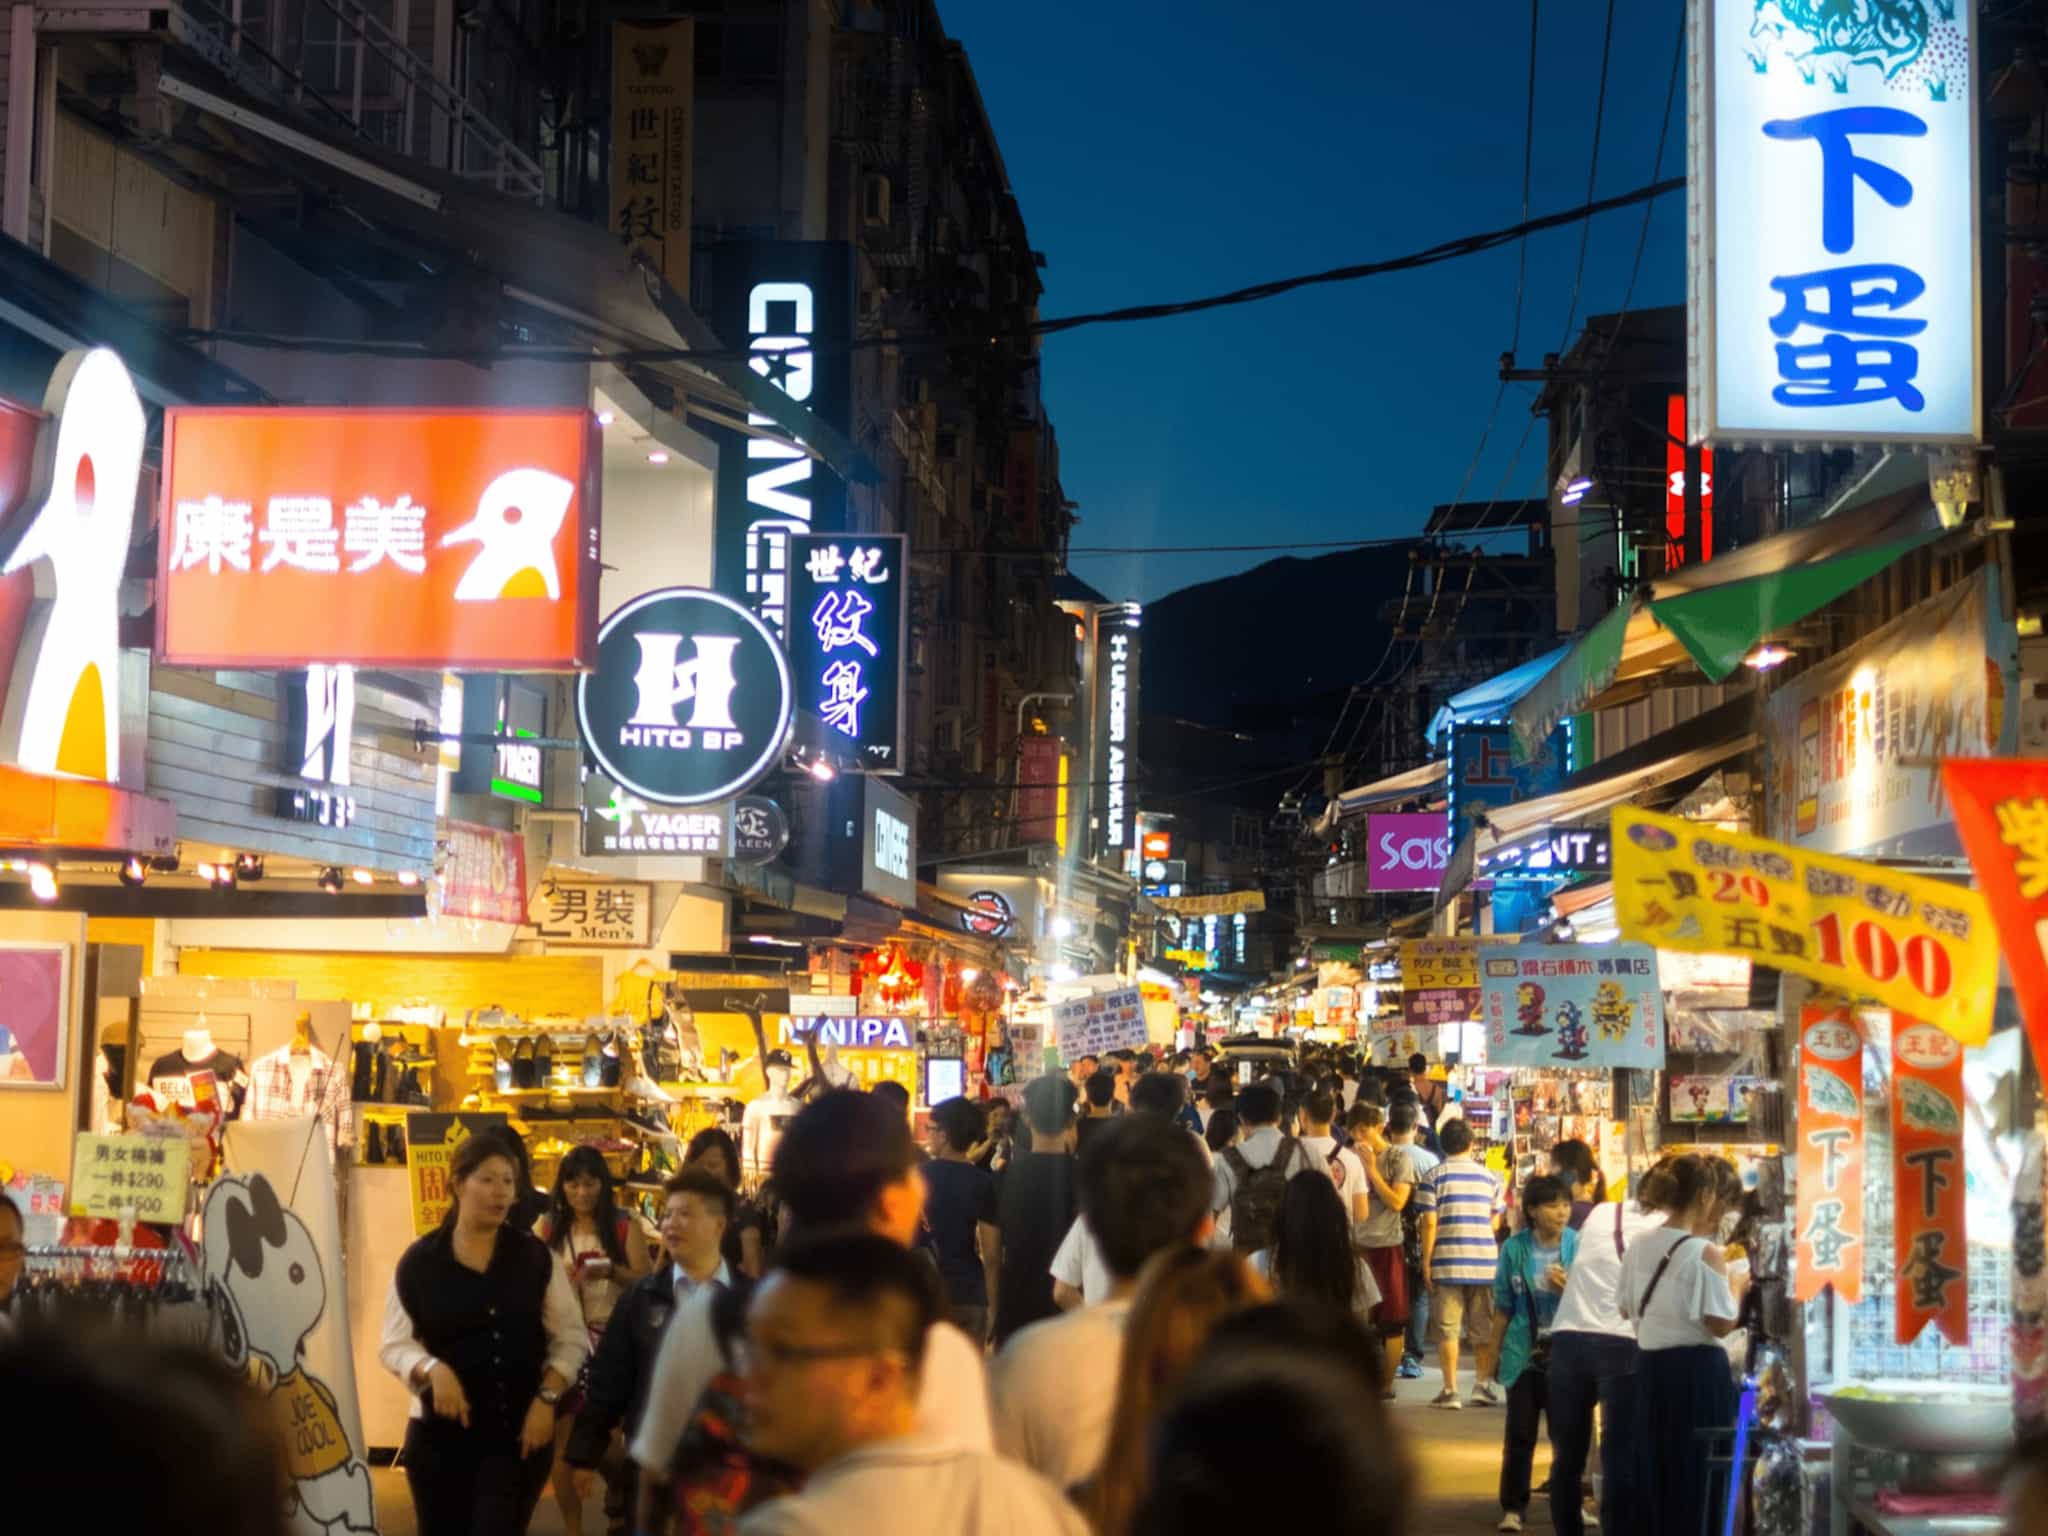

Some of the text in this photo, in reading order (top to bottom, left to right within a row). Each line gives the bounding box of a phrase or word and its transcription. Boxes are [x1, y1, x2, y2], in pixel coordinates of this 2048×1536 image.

[1762, 106, 1928, 412] 下蛋
[170, 495, 427, 574] 康是美
[804, 545, 890, 584] 世紀
[1111, 664, 1126, 742] UNDER
[619, 728, 743, 750] HITO BP
[640, 814, 722, 836] YAGER
[550, 887, 635, 925] 男裝
[580, 926, 635, 940] Men's
[1813, 1032, 1853, 1050] 王記
[1902, 1033, 1950, 1056] 王記
[1804, 1129, 1857, 1269] 下蛋
[1902, 1149, 1961, 1308] 下蛋
